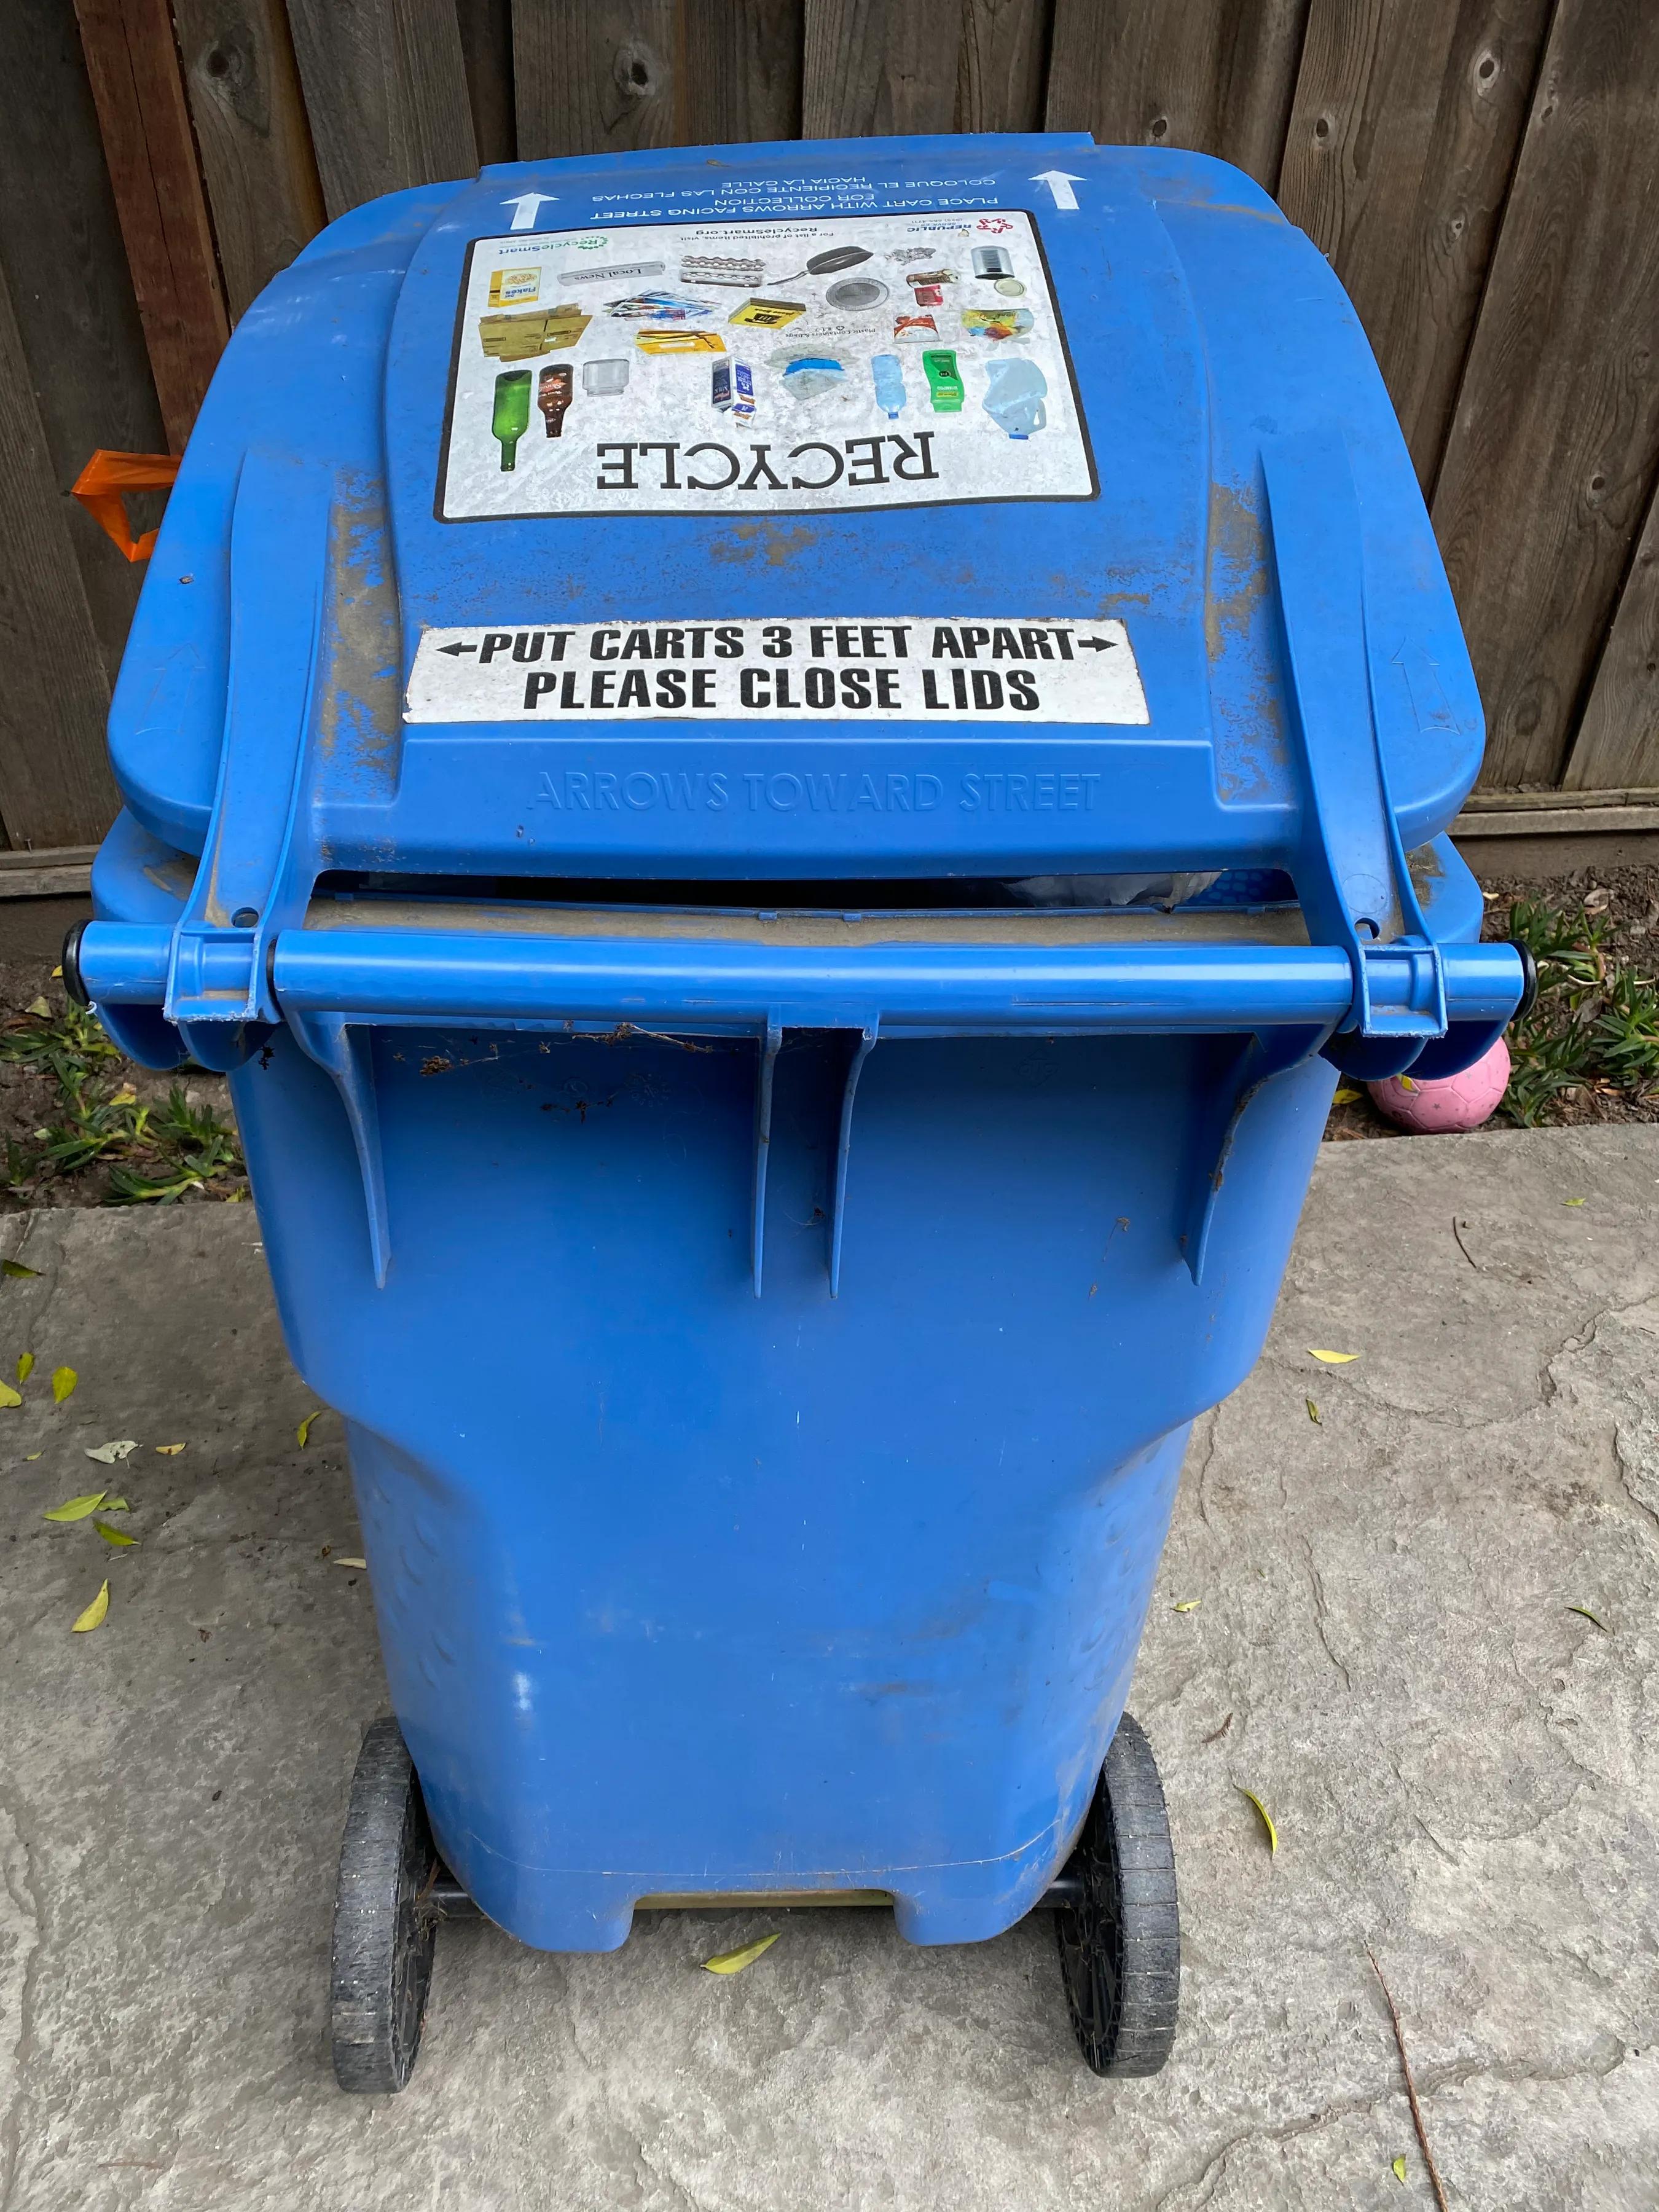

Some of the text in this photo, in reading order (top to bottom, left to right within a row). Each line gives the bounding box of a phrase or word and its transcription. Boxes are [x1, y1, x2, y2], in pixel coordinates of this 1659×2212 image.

[721, 179, 778, 188] CALLE
[766, 182, 872, 194] RECIPIENTE
[903, 179, 996, 188] COLOQUE
[591, 191, 675, 202] FLECHAS
[721, 187, 761, 195] CON
[714, 193, 874, 206] FOR COLLECTION
[589, 197, 998, 219] PLACE CART WITH ARROWS FACING STREET
[695, 227, 817, 236] RecycleSmart.org
[906, 224, 971, 232] REPUBLIC
[498, 240, 597, 255] RecycleSmart
[608, 269, 642, 277] Local
[597, 431, 939, 491] RECYCLE
[477, 626, 1074, 664] PUT CARTS 3 FEET APART
[523, 668, 1040, 712] PLEASE CLOSE LIDS
[528, 771, 1102, 812] ARROWS TOWARD STREET
